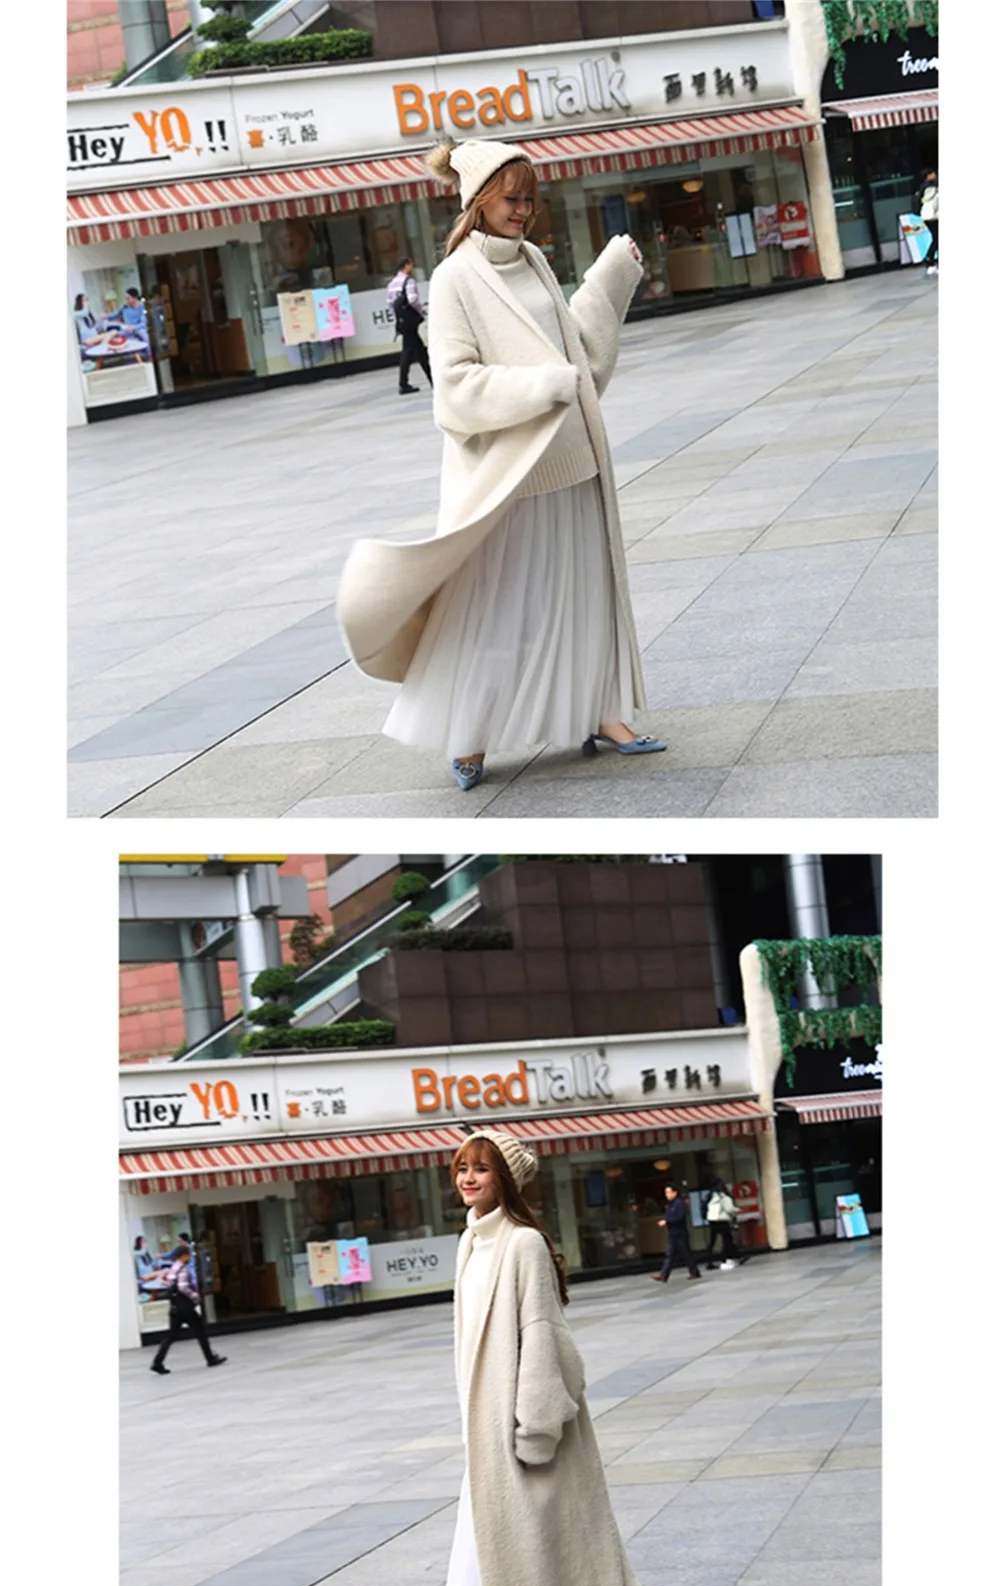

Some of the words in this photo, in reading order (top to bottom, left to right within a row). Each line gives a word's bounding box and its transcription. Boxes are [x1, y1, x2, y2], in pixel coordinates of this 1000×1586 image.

[393, 57, 632, 135] BreadTalk
[281, 109, 315, 121] Yogurt
[67, 134, 124, 162] Hey
[411, 1053, 613, 1113] BreadTalk
[134, 1100, 183, 1126] Hey
